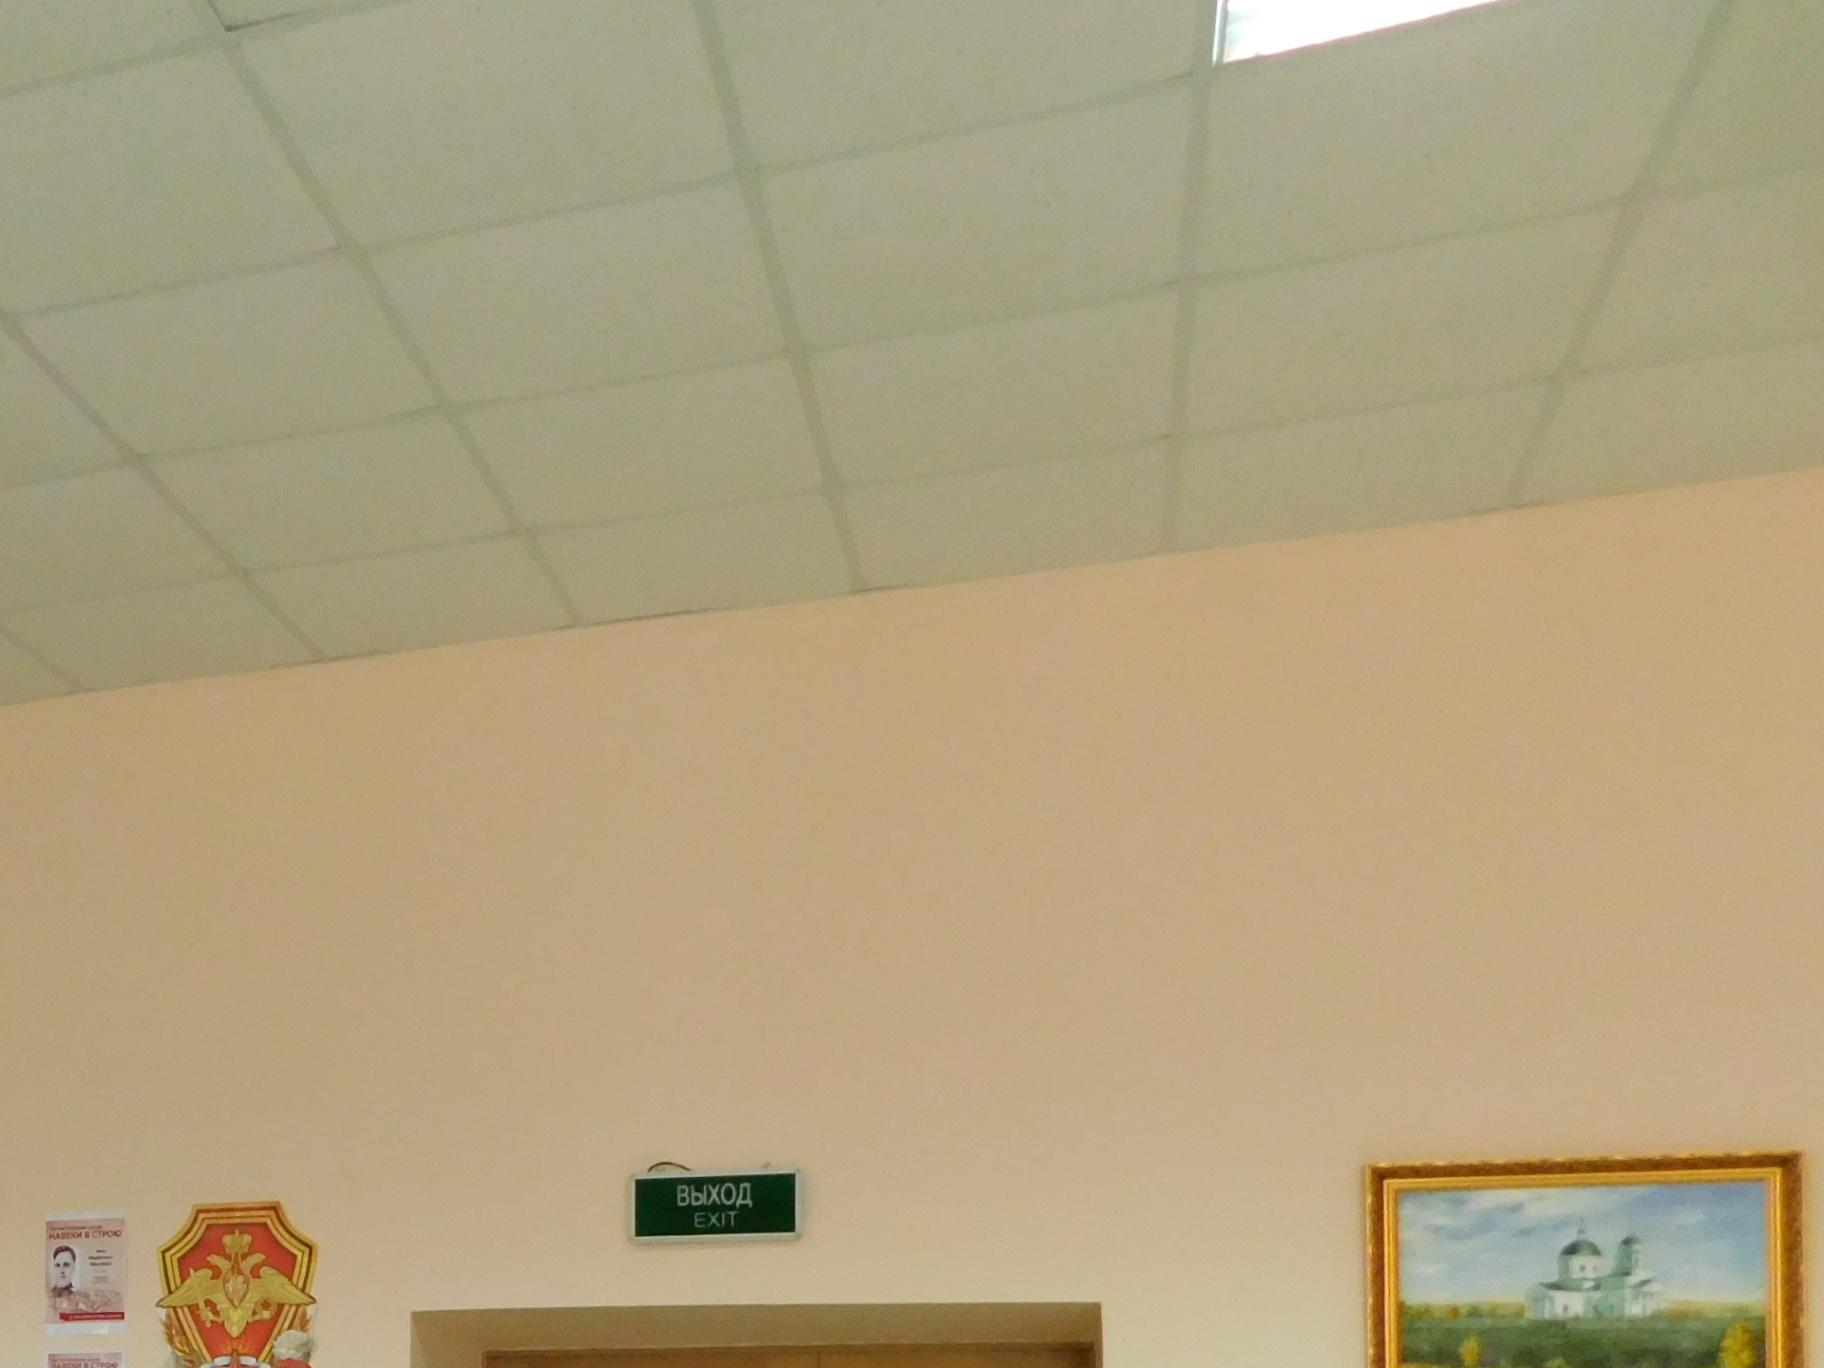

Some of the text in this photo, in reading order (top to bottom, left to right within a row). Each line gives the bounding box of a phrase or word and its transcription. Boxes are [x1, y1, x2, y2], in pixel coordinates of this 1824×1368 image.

[676, 1182, 753, 1208] ВЫХОД
[694, 1210, 739, 1228] EXIT
[92, 1229, 122, 1239] СТРОЮ
